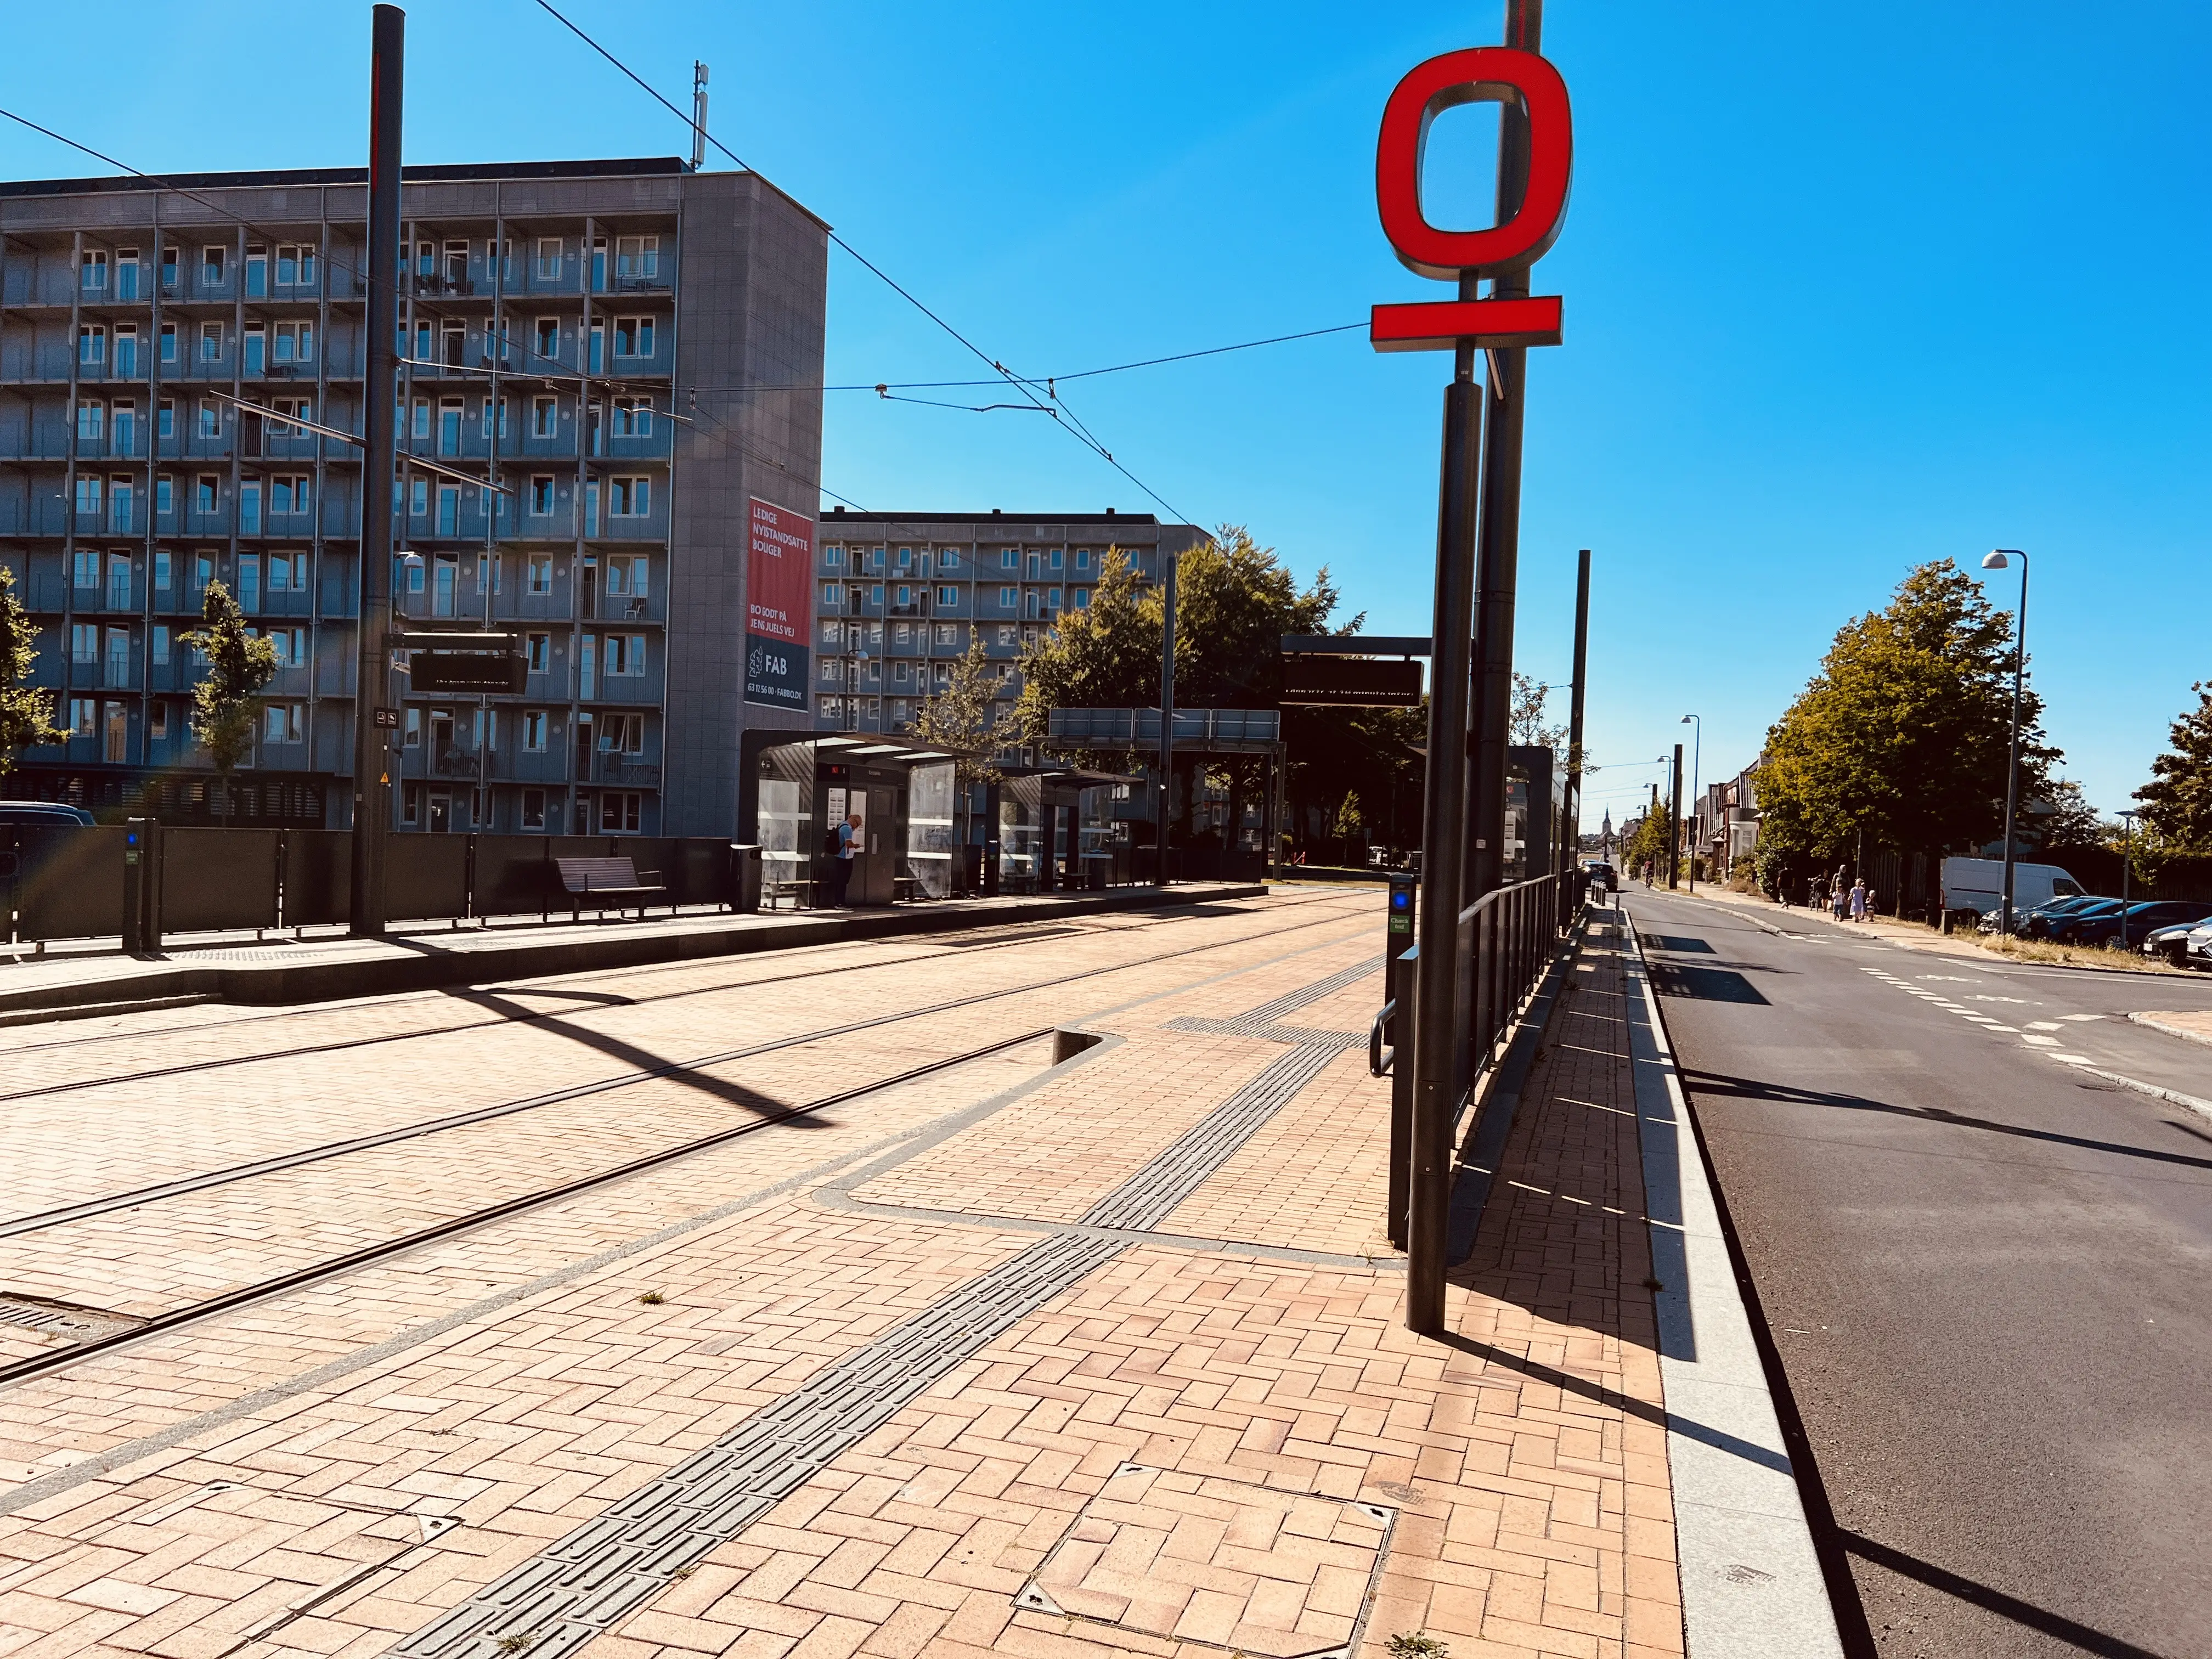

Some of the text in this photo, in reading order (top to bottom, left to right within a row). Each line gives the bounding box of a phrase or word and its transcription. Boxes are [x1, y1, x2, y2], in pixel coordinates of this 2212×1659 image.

[753, 505, 777, 525] LEDIGE
[753, 522, 808, 551] NYISTANDSATTE
[753, 538, 782, 558] BOLIGER
[751, 604, 787, 622] BO GODT PÅ
[751, 618, 795, 637] JENS JUELS VEJ
[765, 654, 787, 675] FAB
[747, 682, 755, 692] 63
[760, 685, 768, 694] 56
[777, 687, 802, 700] FABBO.DK
